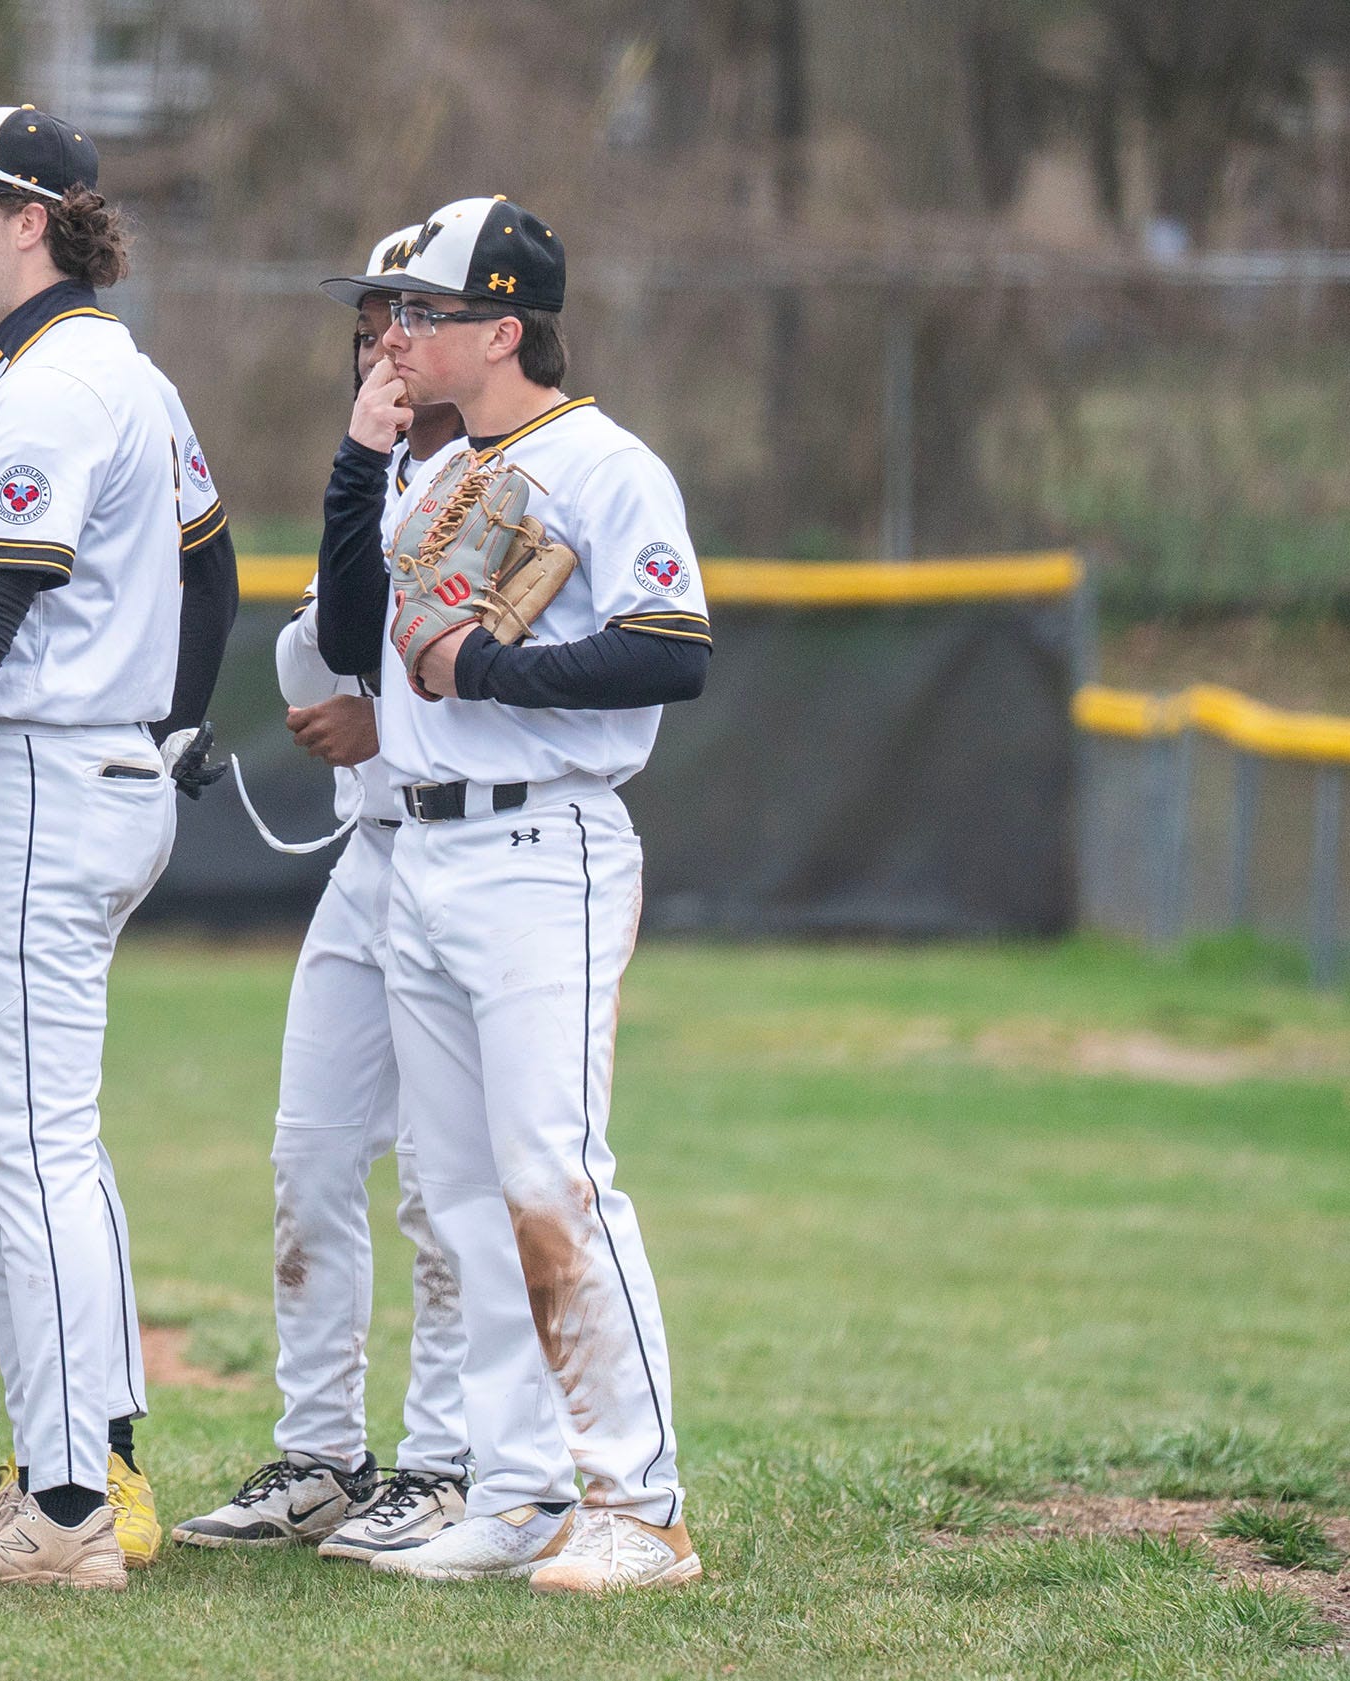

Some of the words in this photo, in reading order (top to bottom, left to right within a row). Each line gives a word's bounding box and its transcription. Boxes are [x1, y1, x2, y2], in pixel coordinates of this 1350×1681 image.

[22, 500, 48, 522] LEAGUE
[432, 571, 471, 607] W
[397, 615, 424, 656] ilson
